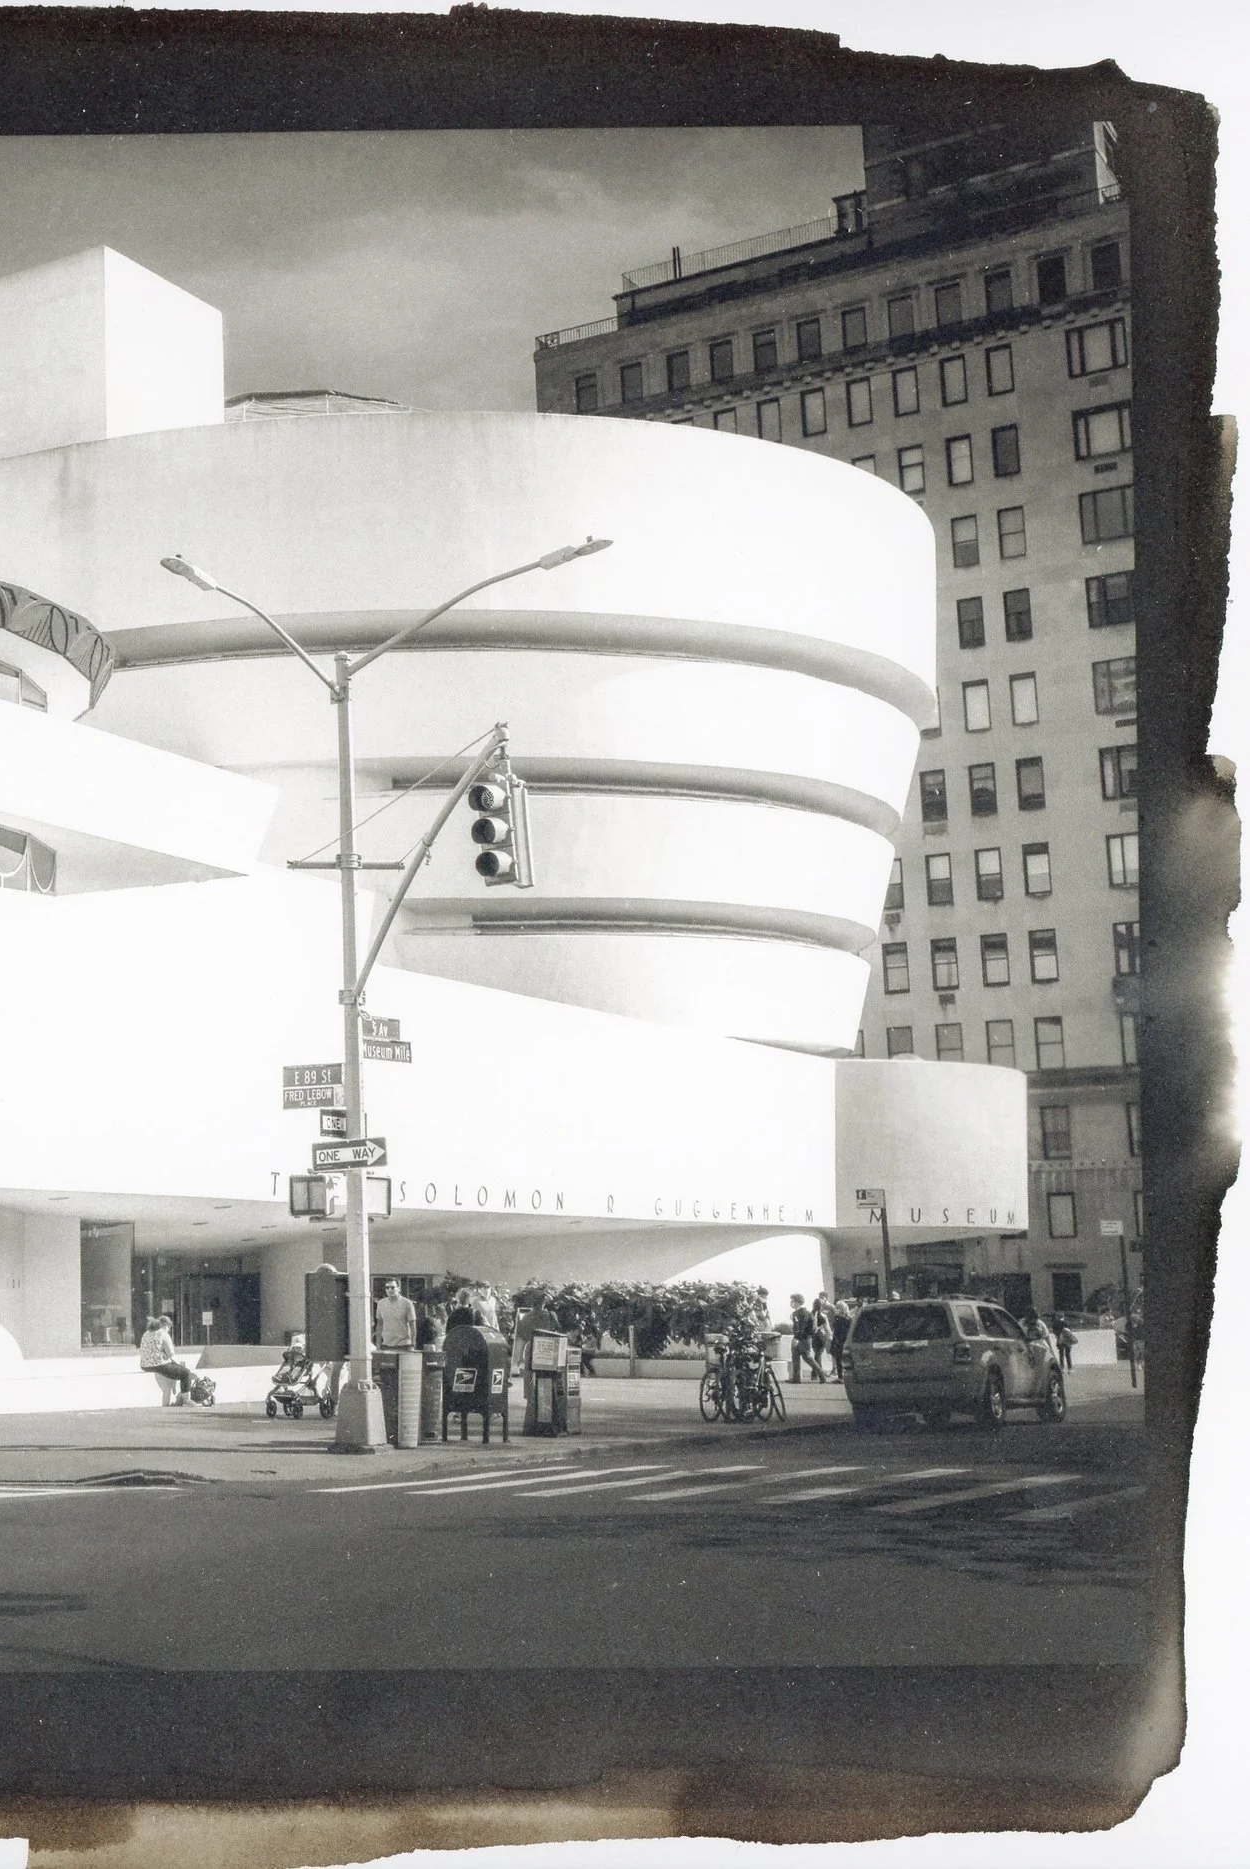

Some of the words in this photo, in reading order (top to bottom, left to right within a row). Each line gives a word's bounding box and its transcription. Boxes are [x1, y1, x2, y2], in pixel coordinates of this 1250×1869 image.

[379, 1023, 388, 1038] Av
[362, 1043, 393, 1059] Museum
[394, 1045, 411, 1061] Mile
[295, 1071, 300, 1085] E
[304, 1070, 317, 1085] 89
[321, 1069, 331, 1083] St
[285, 1090, 304, 1102] FRED
[307, 1088, 332, 1101] LEBOW
[327, 1117, 341, 1130] ONE
[319, 1150, 340, 1162] ONE
[352, 1147, 376, 1160] WAY
[399, 1181, 564, 1211] SOLOMON
[607, 1194, 615, 1214] R
[654, 1197, 815, 1224] GUGGENHEM
[869, 1207, 1016, 1225] MUSEUM
